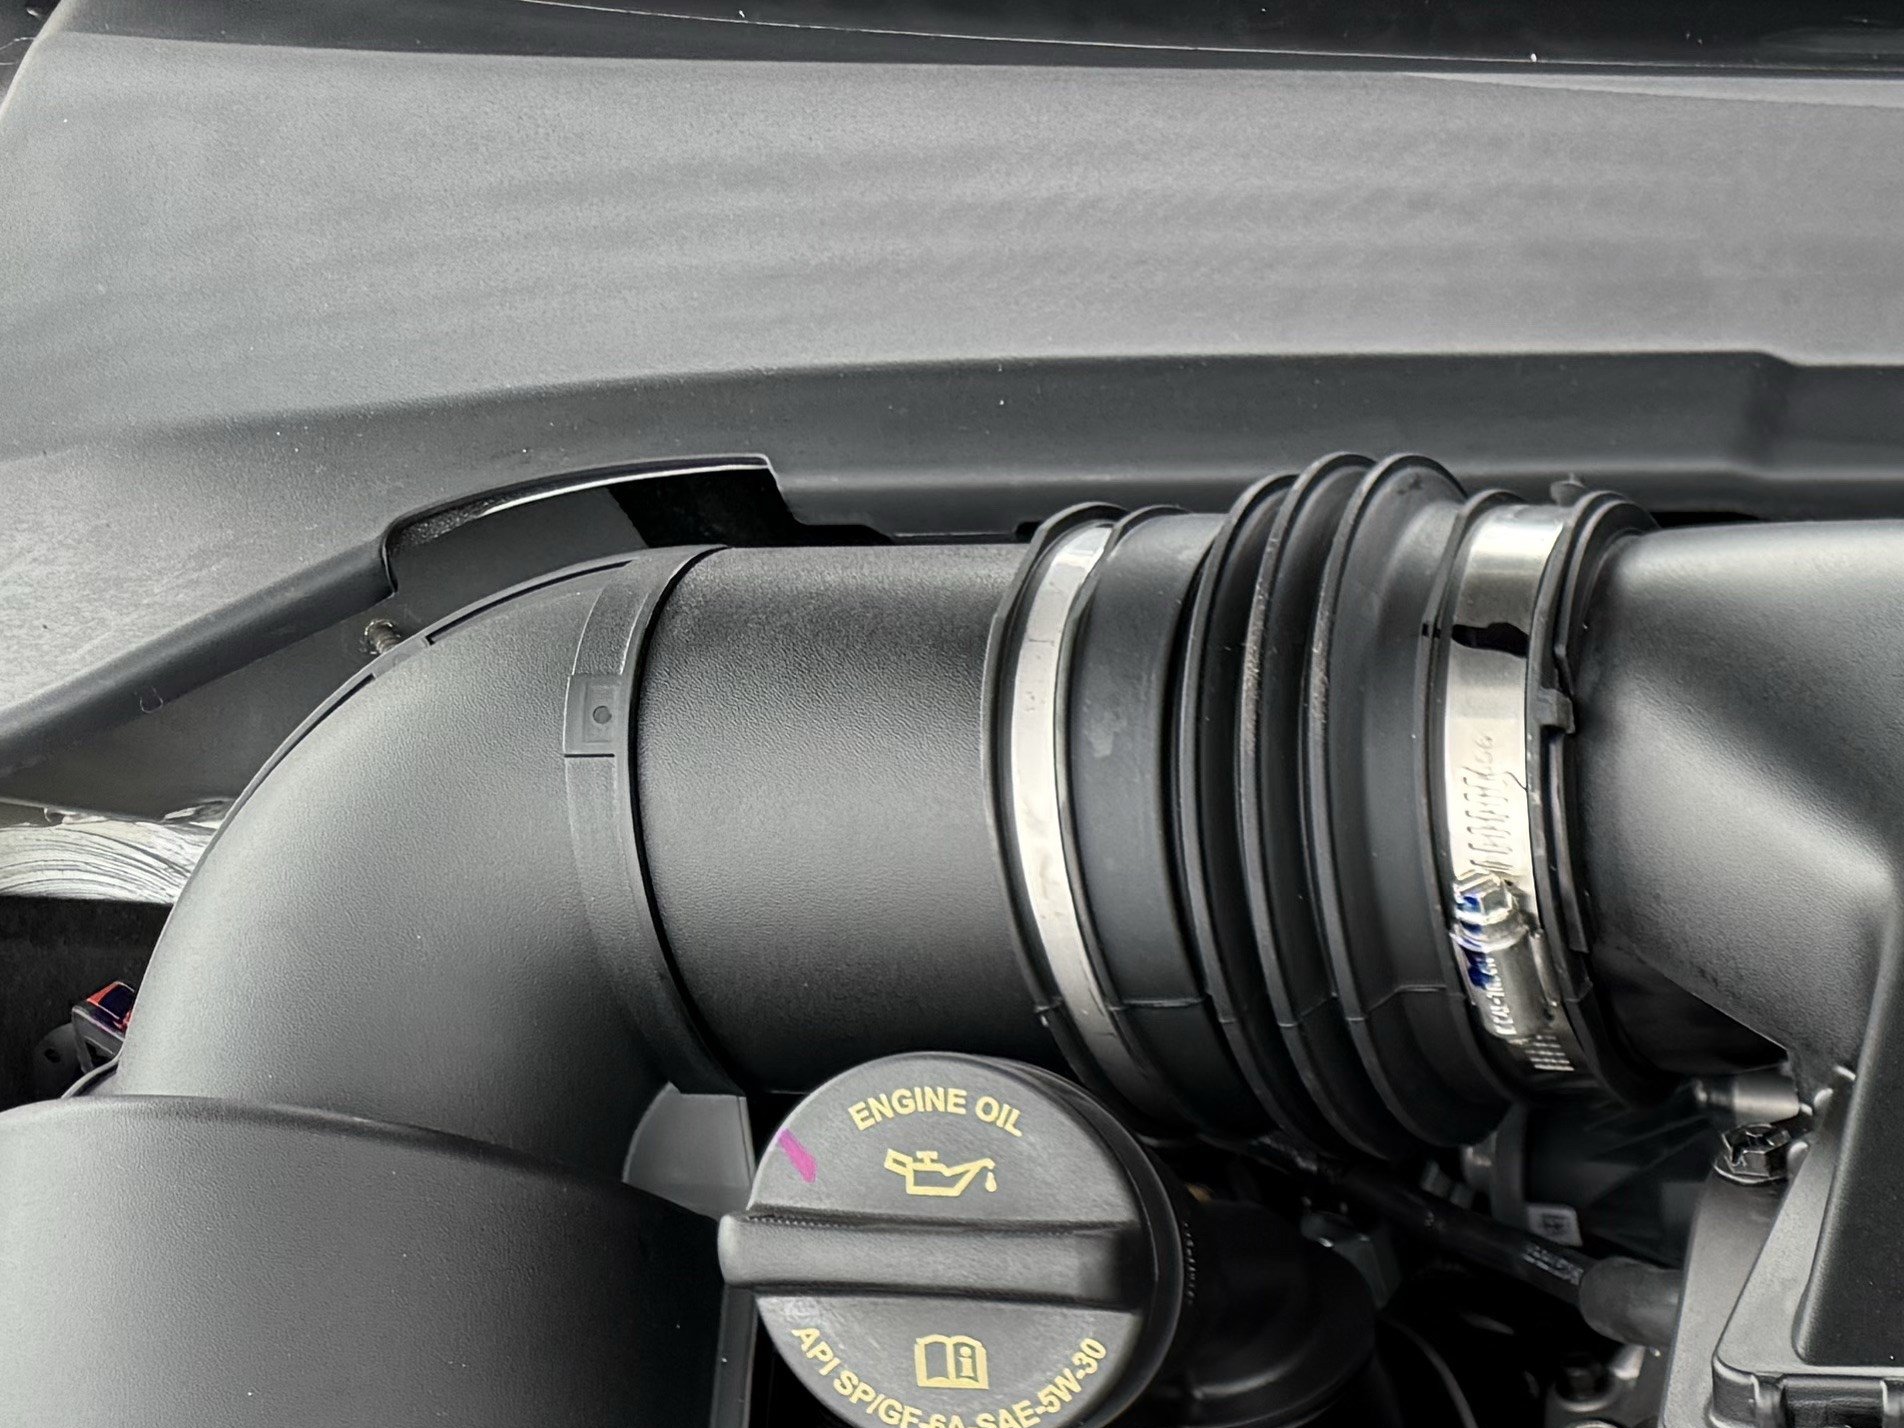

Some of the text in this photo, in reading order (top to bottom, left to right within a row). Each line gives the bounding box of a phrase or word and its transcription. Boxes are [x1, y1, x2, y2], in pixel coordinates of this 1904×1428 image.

[848, 1086, 1023, 1138] ENGINE OIL
[792, 1327, 839, 1375] API
